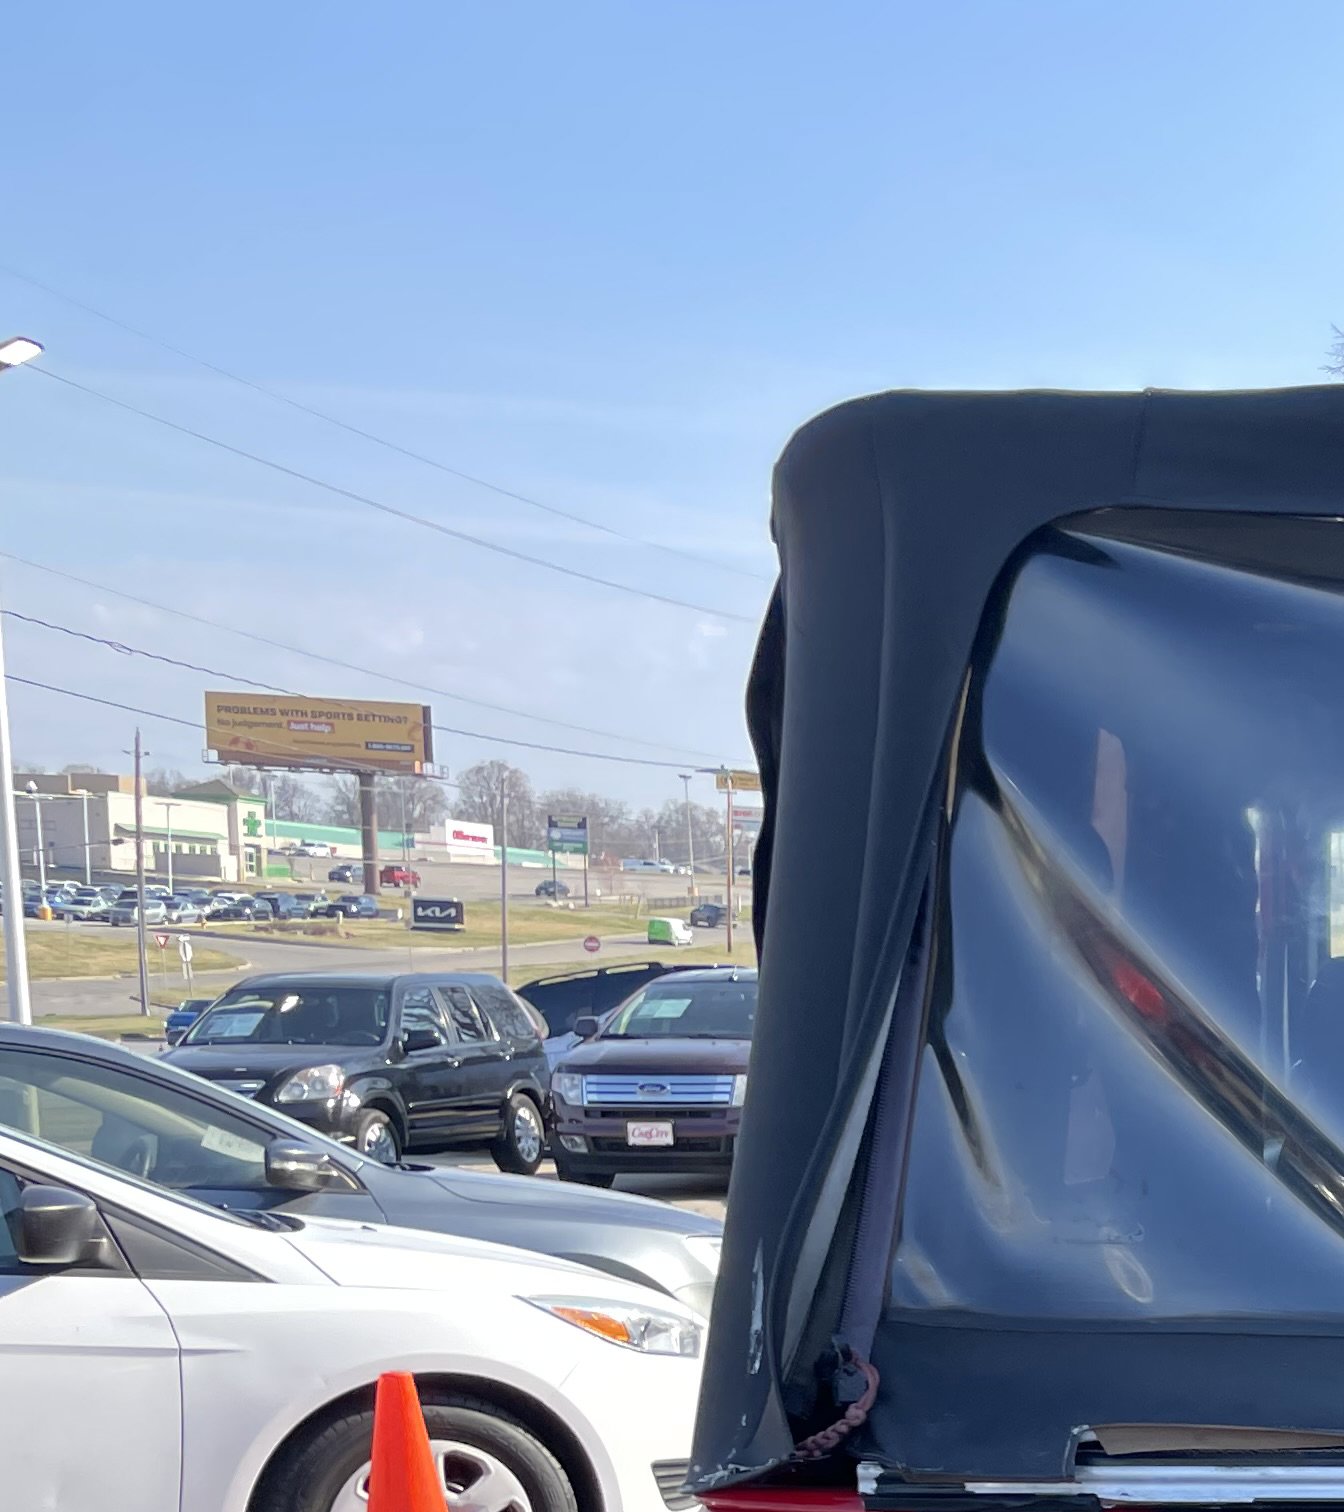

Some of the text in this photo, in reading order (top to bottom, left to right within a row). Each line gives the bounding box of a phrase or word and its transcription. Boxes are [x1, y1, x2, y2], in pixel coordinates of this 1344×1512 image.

[216, 705, 409, 725] PROBLEMS WITH SPORTS BETTING?
[216, 718, 231, 727] No
[289, 720, 309, 731] Just
